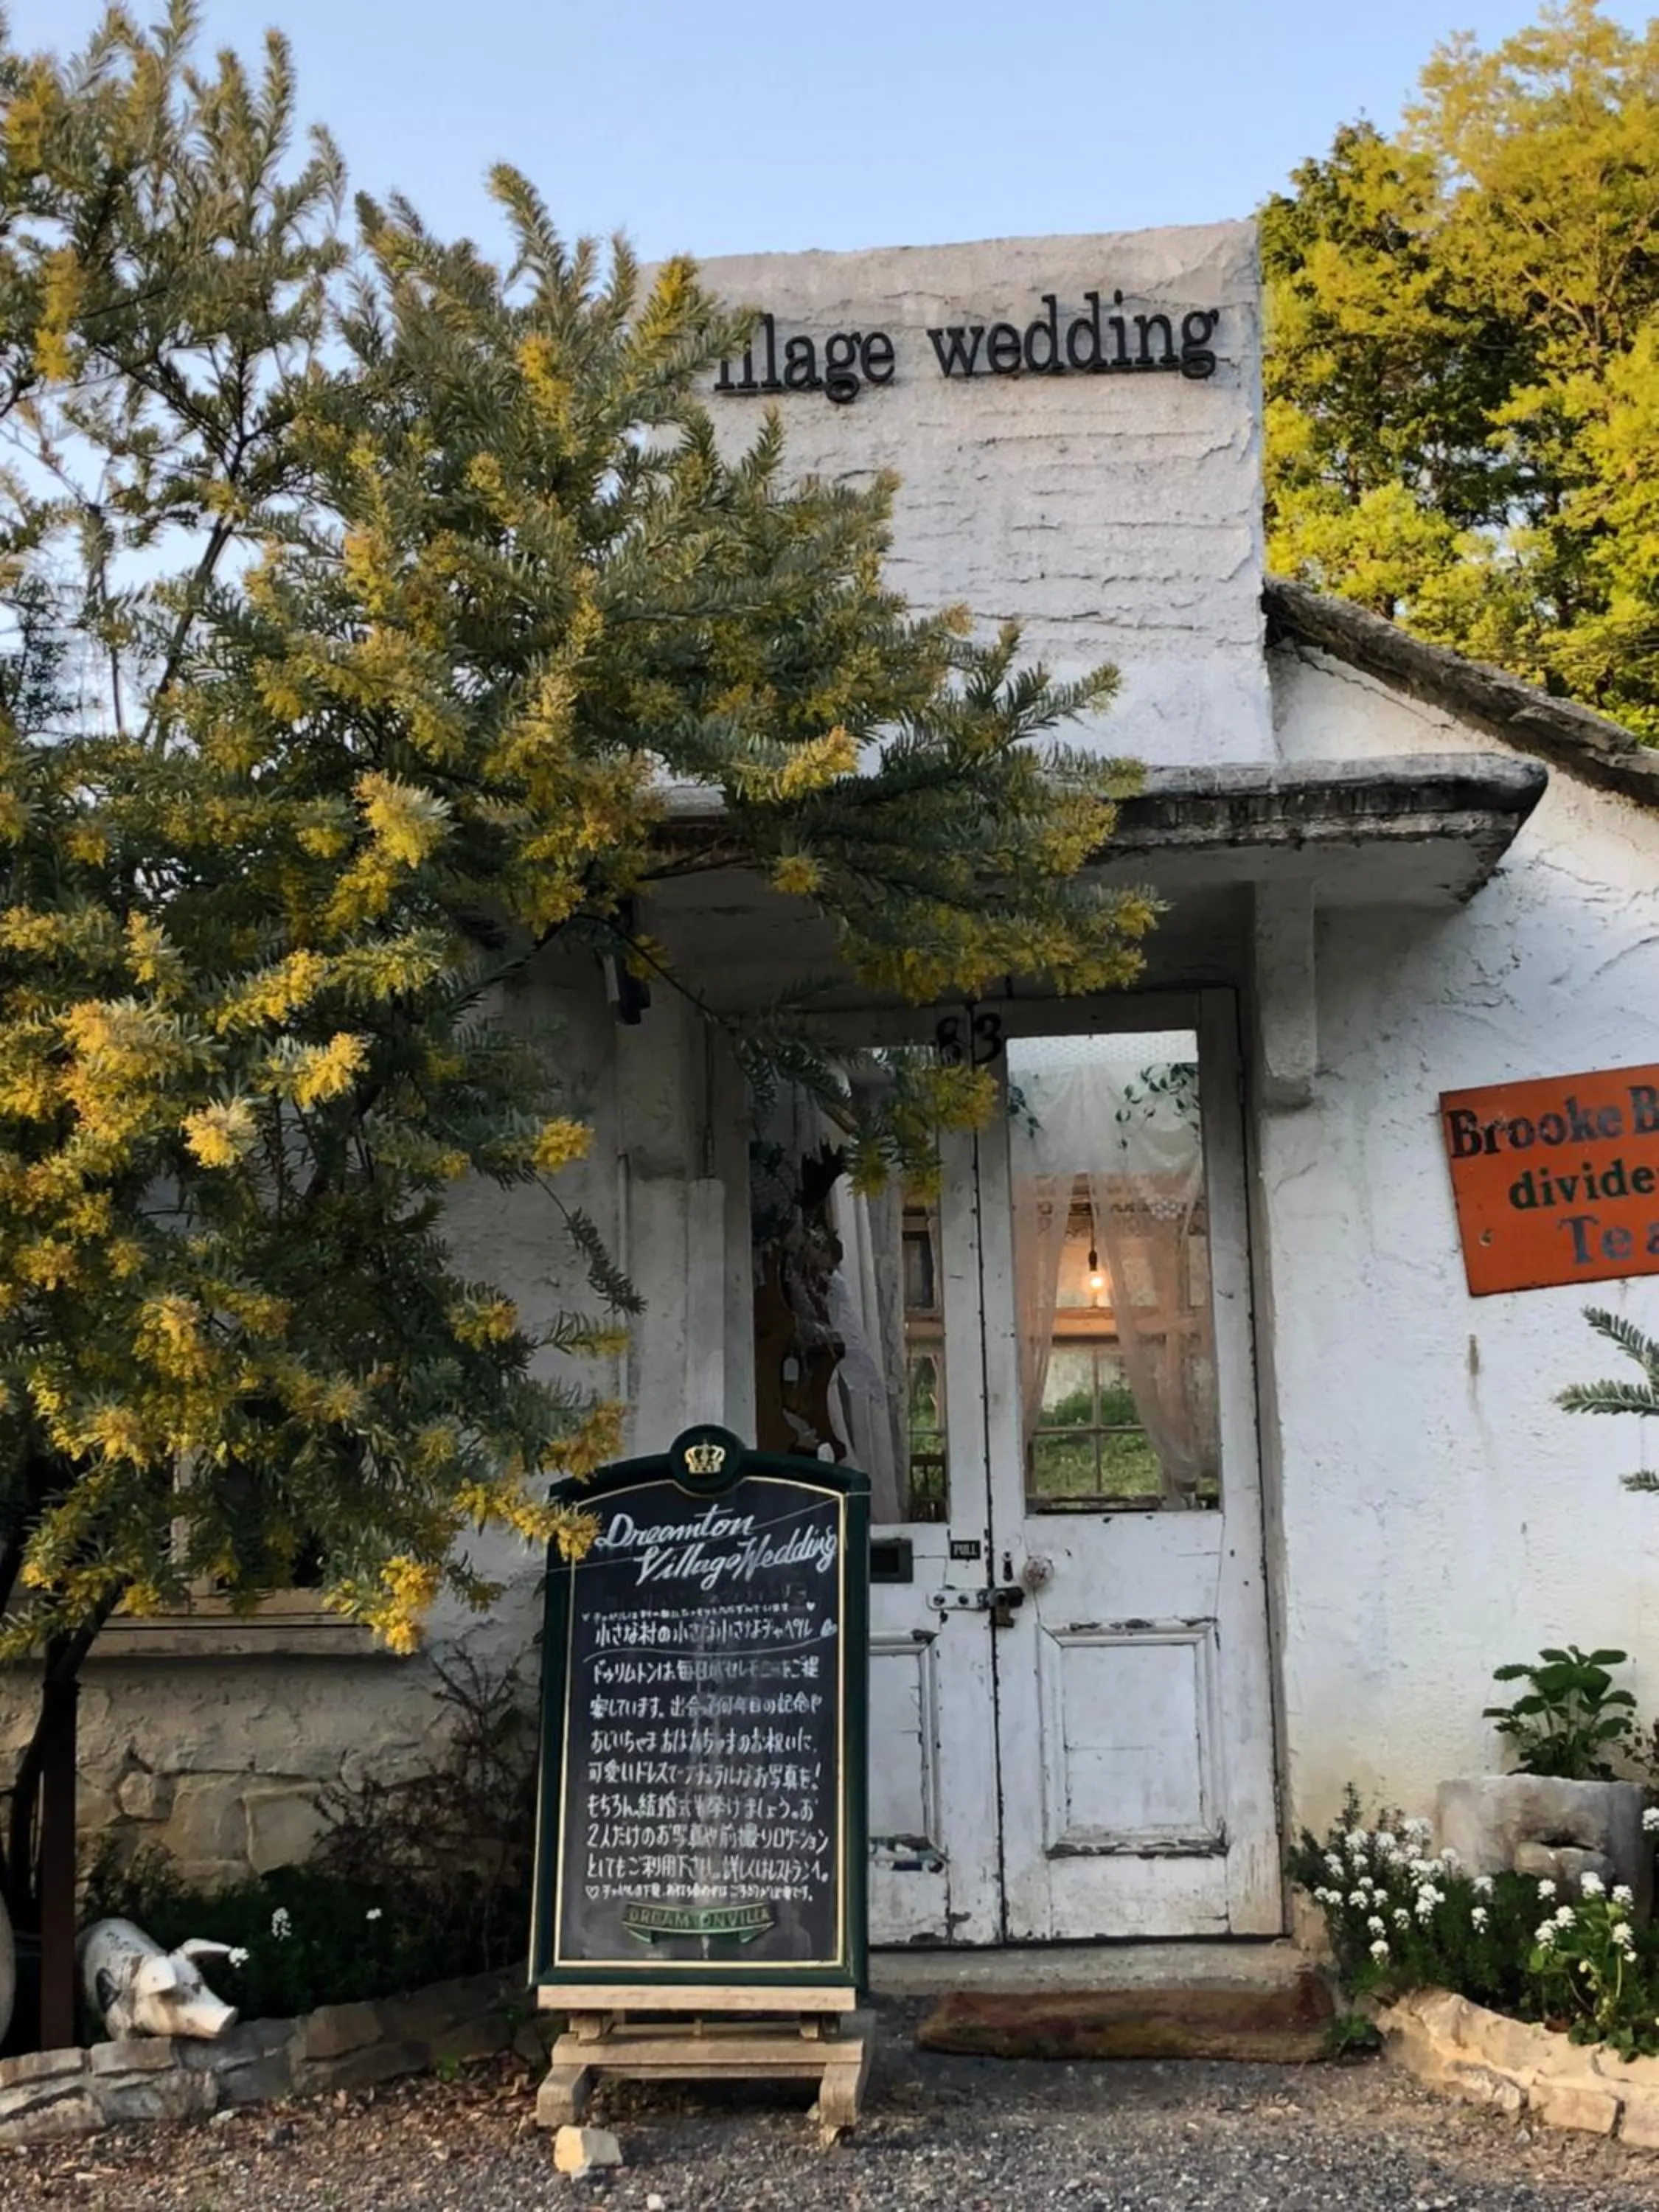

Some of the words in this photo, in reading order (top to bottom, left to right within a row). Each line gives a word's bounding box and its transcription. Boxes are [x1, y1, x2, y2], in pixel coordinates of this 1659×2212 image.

[713, 313, 896, 403] llage
[928, 290, 1220, 380] wedding
[1446, 1096, 1623, 1159] Brooke
[1509, 1158, 1659, 1210] divide
[594, 1503, 755, 1549] Dreamton
